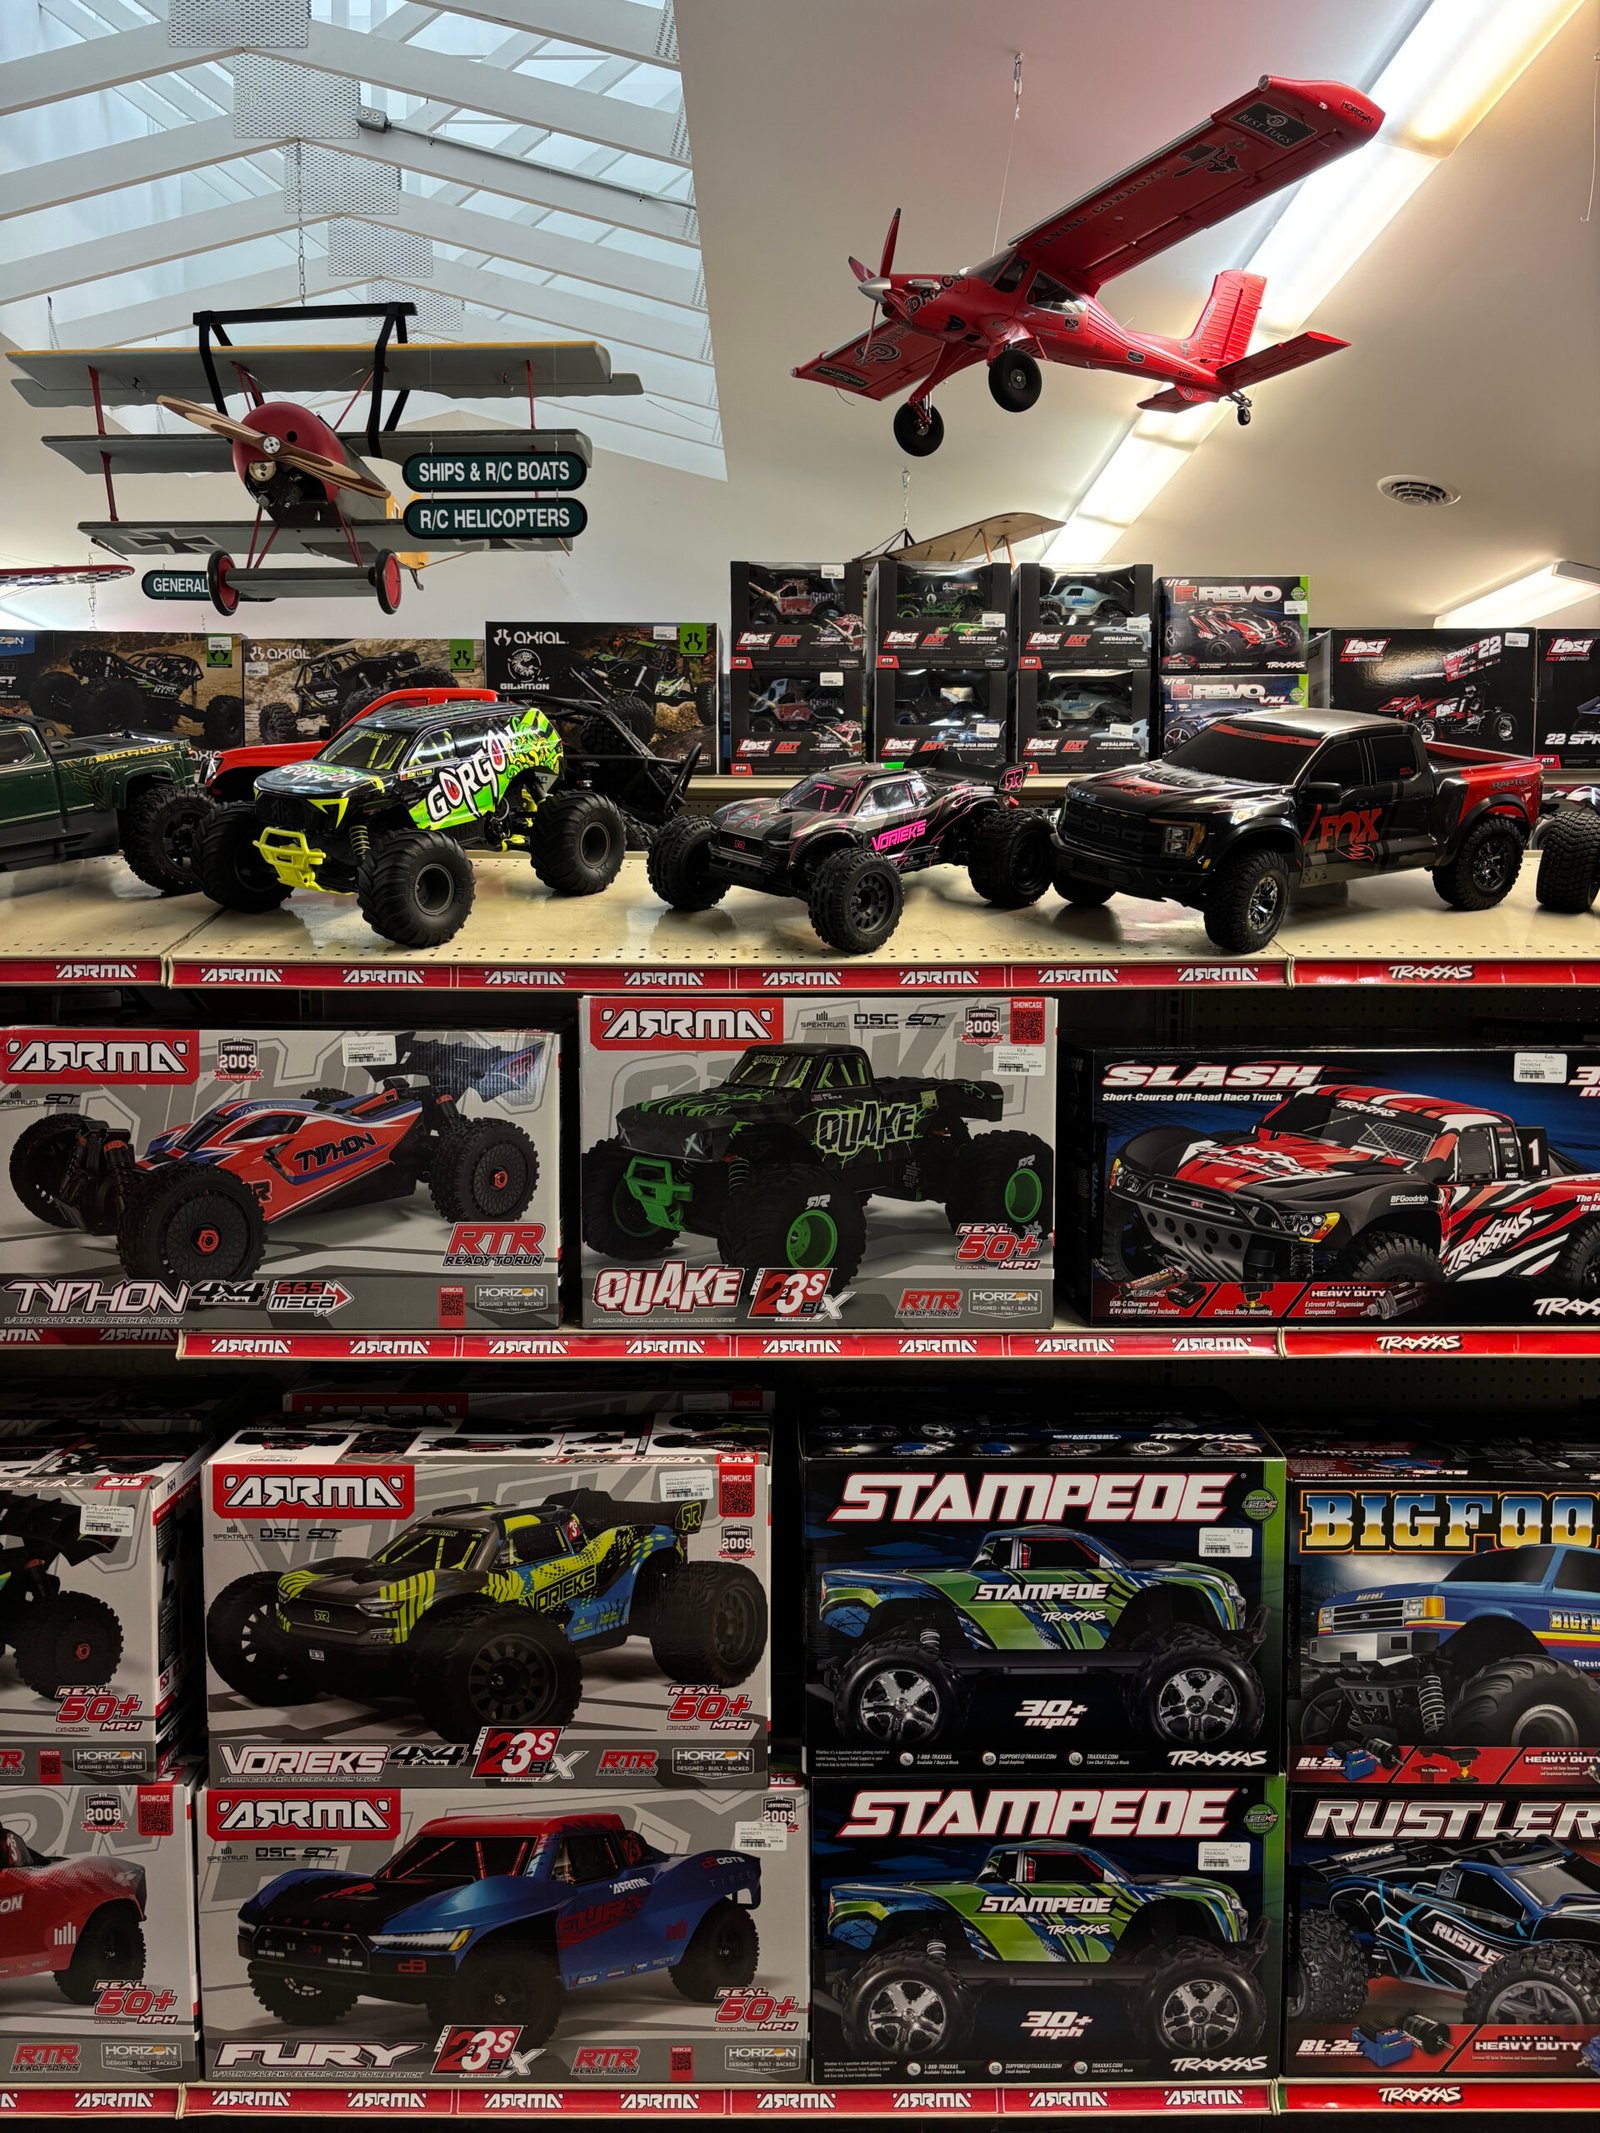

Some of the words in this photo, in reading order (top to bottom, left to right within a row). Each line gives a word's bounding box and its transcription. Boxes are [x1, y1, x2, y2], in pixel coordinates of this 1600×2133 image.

[1238, 112, 1263, 129] BEST
[1265, 126, 1292, 145] TUGS
[1091, 167, 1169, 214] COWBOYS
[419, 462, 465, 483] SHIPS
[470, 461, 481, 482] &
[485, 462, 513, 485] R/C
[518, 461, 570, 482] BOATS
[420, 509, 449, 534] R/C
[457, 508, 570, 532] HELICOPTERS
[152, 577, 210, 594] GENERAL
[741, 632, 775, 646] LOSI
[885, 631, 920, 645] LOSI
[1030, 631, 1064, 645] LOSI
[1343, 639, 1389, 655] LOSI
[1446, 646, 1478, 662] SPRINT
[1477, 636, 1502, 659] 22
[1550, 639, 1594, 655] LOSI
[1544, 734, 1566, 745] 22
[425, 722, 522, 822] GORGON
[870, 817, 928, 853] VORTEKS
[1315, 806, 1384, 851] FOX
[55, 964, 139, 979] ARRMA
[200, 968, 284, 983] ARRMA
[341, 969, 425, 985] ARRMA
[483, 970, 567, 985] ARRMA
[623, 971, 705, 987] ARRMA
[761, 971, 843, 986] ARRMA
[899, 970, 980, 986] ARRMA
[1037, 968, 1120, 985] ARRMA
[1176, 967, 1259, 983] ARRMA
[1386, 965, 1475, 980] TRAXXAS
[1012, 1001, 1044, 1009] SHOWCASE
[600, 1008, 774, 1041] ARRMA
[853, 1013, 899, 1025] DSC
[905, 1013, 946, 1026] SCT
[965, 1021, 1000, 1034] 2009
[6, 1039, 190, 1074] ARRMA
[219, 1054, 258, 1070] 2009
[1101, 1063, 1326, 1088] SLASH
[1102, 1092, 1175, 1102] Short-Course
[1175, 1092, 1222, 1102] Off-Road
[1222, 1092, 1250, 1102] Race
[1252, 1092, 1284, 1102] Truck
[816, 1099, 920, 1157] QUAKE
[293, 1132, 378, 1172] TYPHON
[1528, 1138, 1540, 1167] 1
[1389, 1195, 1429, 1203] BFGoodrich
[1575, 1194, 1592, 1204] The
[958, 1224, 1012, 1235] REAL
[955, 1233, 1041, 1262] 50+
[443, 1255, 494, 1267] READY
[494, 1255, 514, 1267] TO
[514, 1255, 545, 1267] RUN
[998, 1261, 1041, 1270] MPH
[480, 1287, 545, 1298] HORIZON
[592, 1259, 745, 1318] QUAKE
[972, 1291, 1039, 1301] HORIZON
[1311, 1289, 1353, 1298] HEAVY
[1354, 1289, 1386, 1298] DUTY
[3, 1279, 192, 1315] TYPHON
[348, 1340, 432, 1355] ARRMA
[624, 1340, 707, 1355] ARRMA
[897, 1339, 979, 1354] ARRMA
[1171, 1337, 1253, 1353] ARRMA
[721, 1474, 753, 1482] SHOWCASE
[825, 1471, 1240, 1523] STAMPEDE
[260, 1528, 300, 1539] DSC
[305, 1528, 343, 1540] SCT
[721, 1538, 754, 1550] 2009
[523, 1562, 598, 1615] VORTEKS
[974, 1583, 1111, 1602] STAMPEDE
[57, 1686, 112, 1696] REAL
[669, 1686, 721, 1695] REAL
[56, 1695, 142, 1723] 50+
[667, 1694, 753, 1722] 50+
[1013, 1699, 1089, 1718] 30+
[100, 1721, 143, 1732] MPH
[710, 1720, 752, 1731] MPH
[1023, 1716, 1080, 1730] mph
[76, 1750, 143, 1761] HORIZON
[219, 1743, 392, 1777] VORTEKS
[676, 1750, 751, 1761] HORIZON
[1525, 1755, 1561, 1765] HEAVY
[1562, 1755, 1600, 1765] DUTY
[218, 1799, 391, 1831] ARRMA
[834, 1787, 1240, 1839] STAMPEDE
[1303, 1799, 1600, 1841] RUSTLER
[255, 1847, 297, 1857] DSC
[302, 1847, 338, 1858] SCT
[979, 1896, 1116, 1914] STAMPEDE
[96, 1980, 147, 1991] REAL
[716, 1987, 769, 1998] REAL
[137, 2014, 178, 2025] MPH
[757, 2021, 799, 2032] MPH
[1019, 2010, 1094, 2028] 30+
[1029, 2026, 1085, 2041] mph
[1474, 2041, 1534, 2052] HEAVY
[1537, 2041, 1585, 2052] DUTY
[214, 2041, 425, 2069] FURY
[244, 2070, 271, 2078] SCALE
[291, 2070, 332, 2078] ELECTRIC
[331, 2070, 361, 2078] SHORT
[393, 2070, 425, 2079] TRUCK
[74, 2092, 156, 2108] ARRMA
[346, 2092, 427, 2109] ARRMA
[619, 2093, 700, 2109] ARRMA
[892, 2091, 973, 2108] ARRMA
[1163, 2089, 1245, 2106] ARRMA
